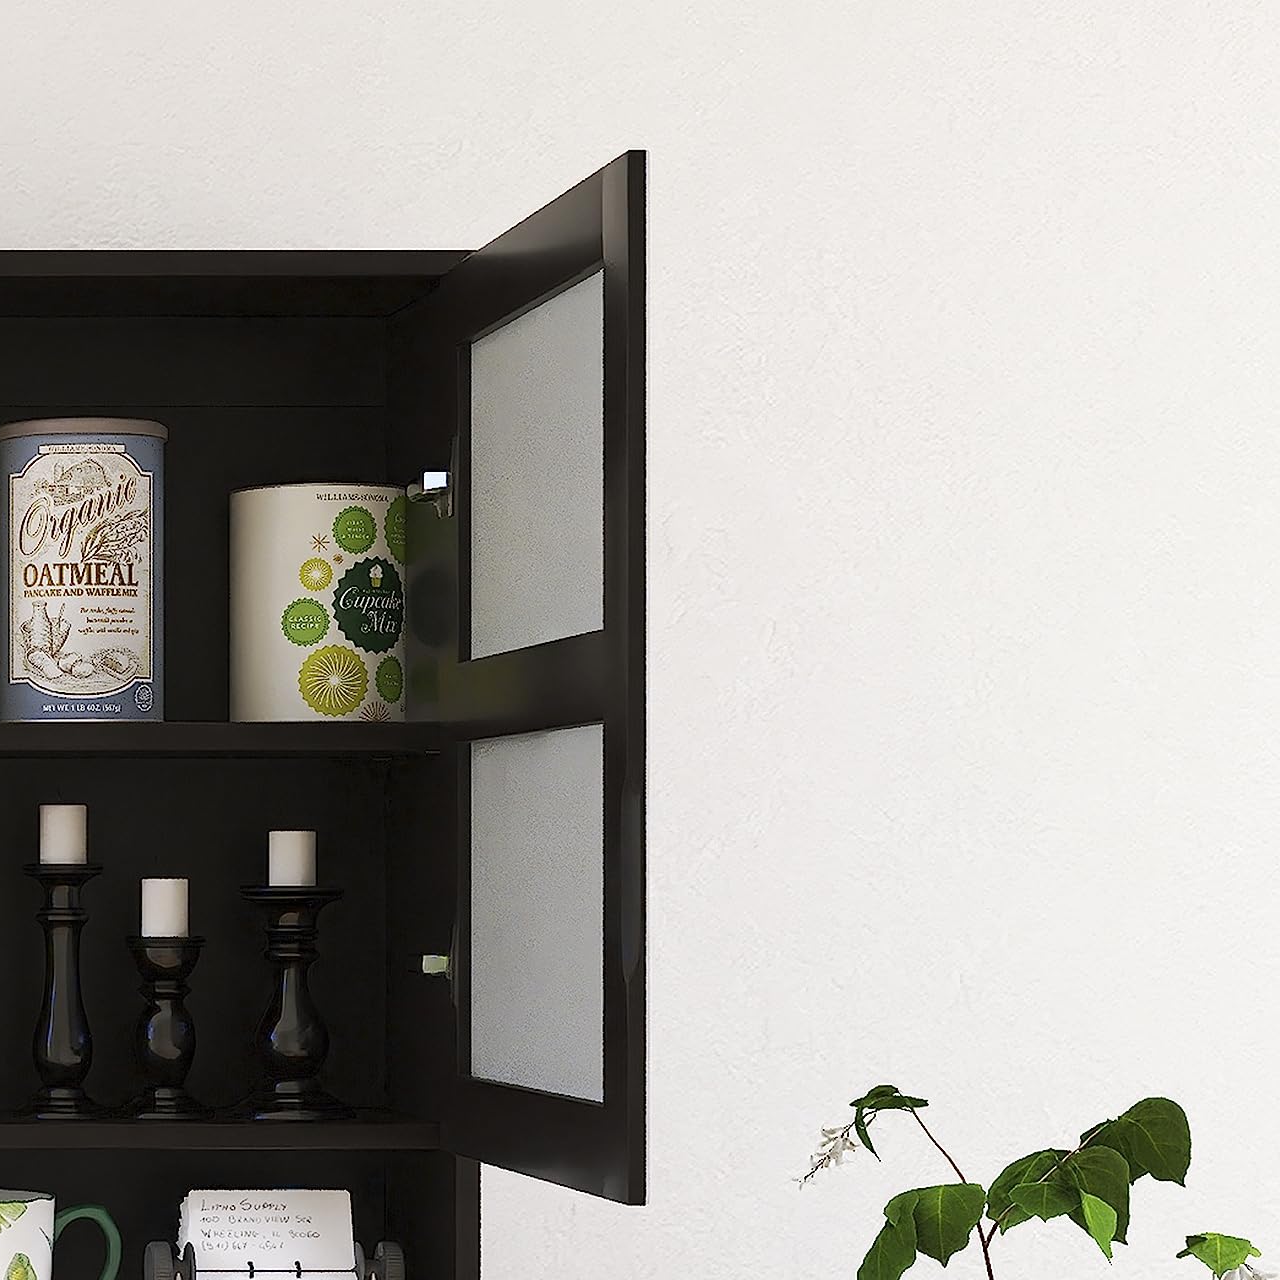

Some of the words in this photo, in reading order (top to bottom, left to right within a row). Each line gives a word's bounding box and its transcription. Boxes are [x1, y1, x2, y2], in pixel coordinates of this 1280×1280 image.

[19, 474, 136, 558] Organic
[24, 563, 139, 587] OATMEAL
[24, 588, 61, 598] PANCAKE
[63, 588, 83, 597] AND
[85, 588, 121, 597] WAFFLE
[122, 588, 138, 598] MIX
[340, 586, 401, 614] Cupcake
[361, 610, 397, 633] Mix
[240, 1198, 287, 1211] SUPPLY
